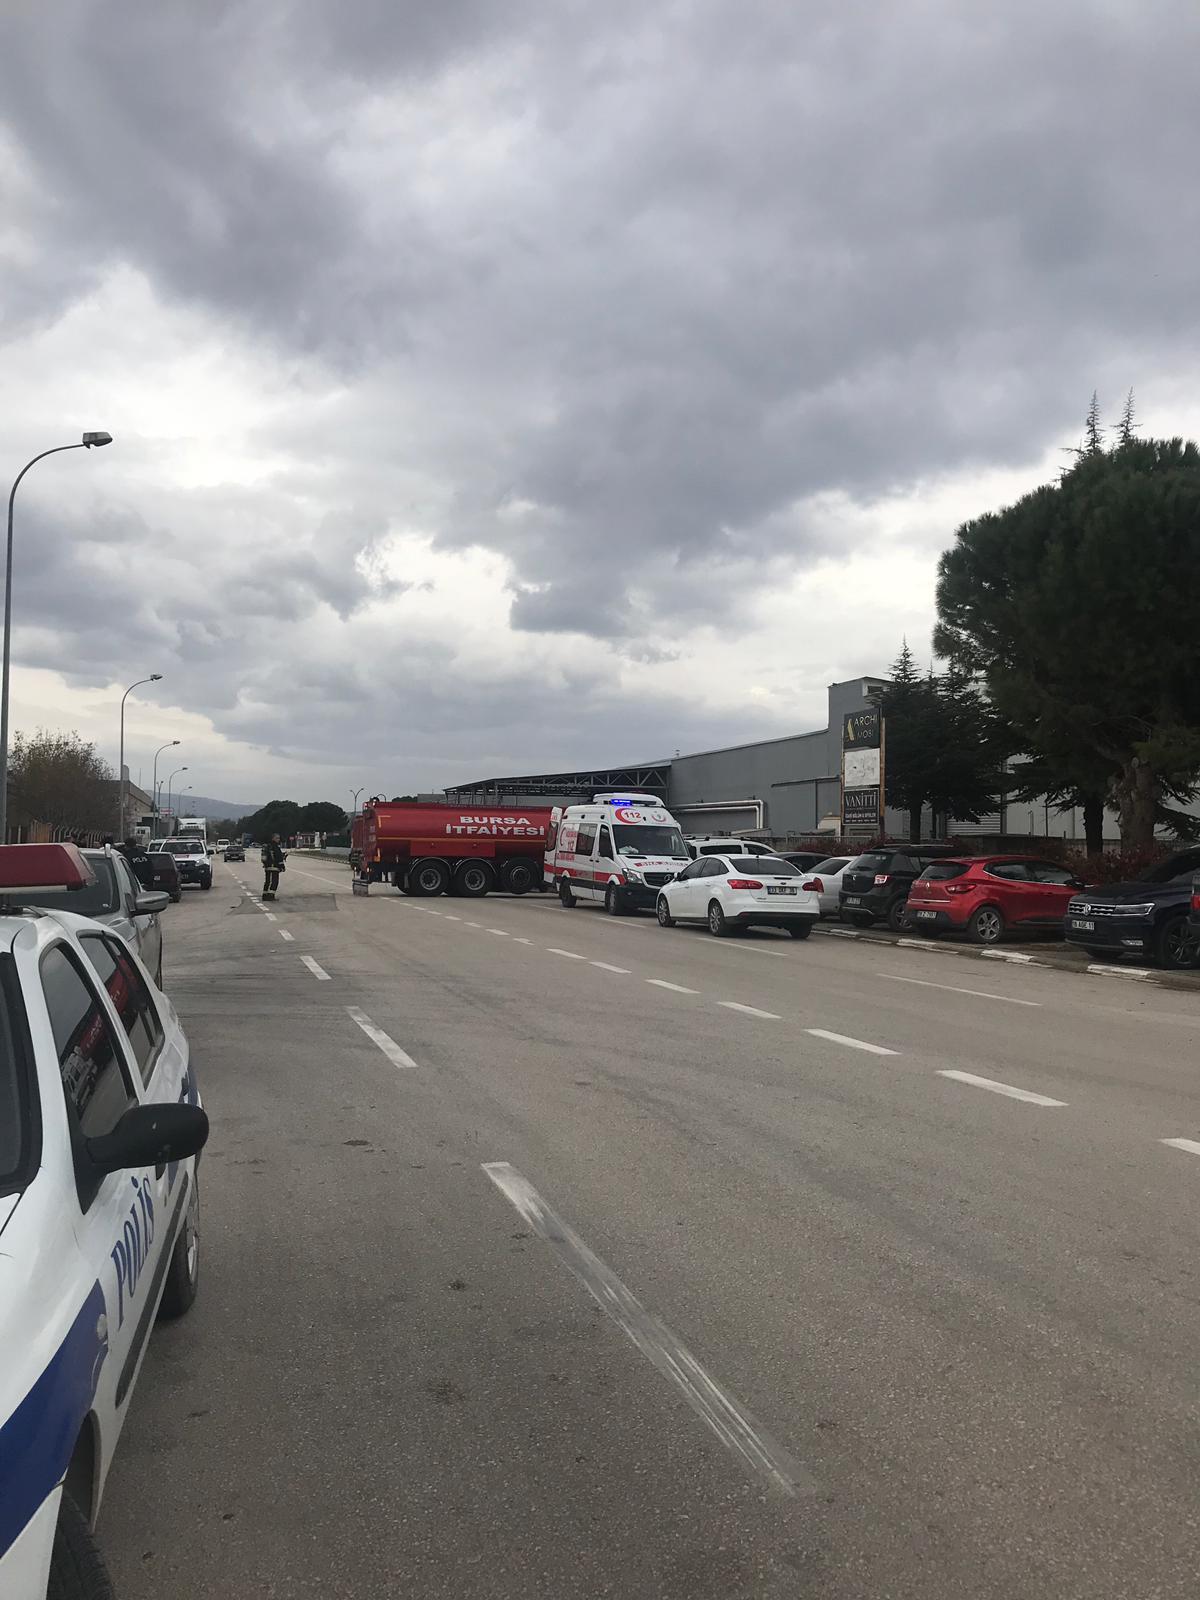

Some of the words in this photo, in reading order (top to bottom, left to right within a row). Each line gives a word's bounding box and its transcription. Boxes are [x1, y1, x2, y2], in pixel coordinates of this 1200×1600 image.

[460, 816, 531, 825] BURSA
[624, 811, 642, 819] 112
[446, 823, 545, 836] İTFAİYESİ
[111, 1173, 154, 1330] POLİS
